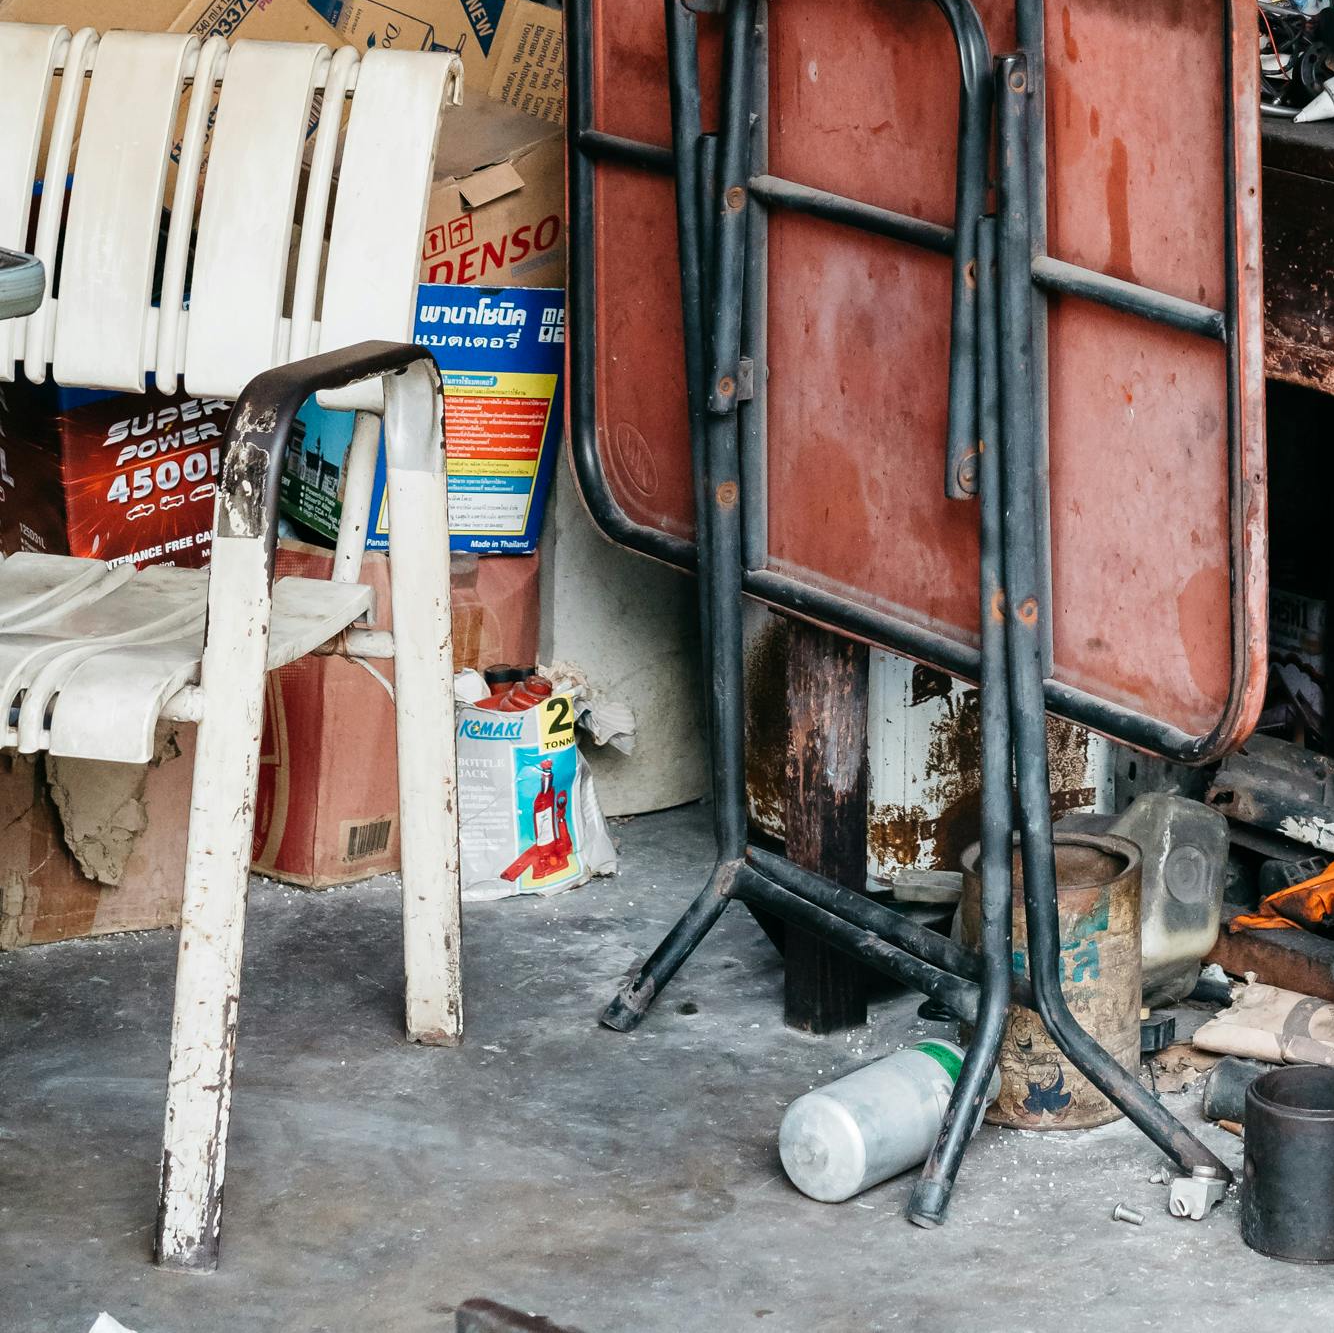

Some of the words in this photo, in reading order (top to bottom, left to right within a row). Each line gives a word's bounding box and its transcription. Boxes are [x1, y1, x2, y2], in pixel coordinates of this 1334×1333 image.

[427, 213, 562, 287] DENSO
[419, 300, 528, 327] พานาโซนิค
[102, 397, 233, 447] SUPER
[115, 421, 223, 467] POWER
[164, 535, 195, 556] FREE
[470, 540, 490, 549] Made
[499, 539, 529, 549] Thailand
[458, 716, 525, 741] KOMAKI
[546, 697, 573, 735] 2
[458, 758, 505, 768] BOTTLE
[458, 769, 489, 779] JACK
